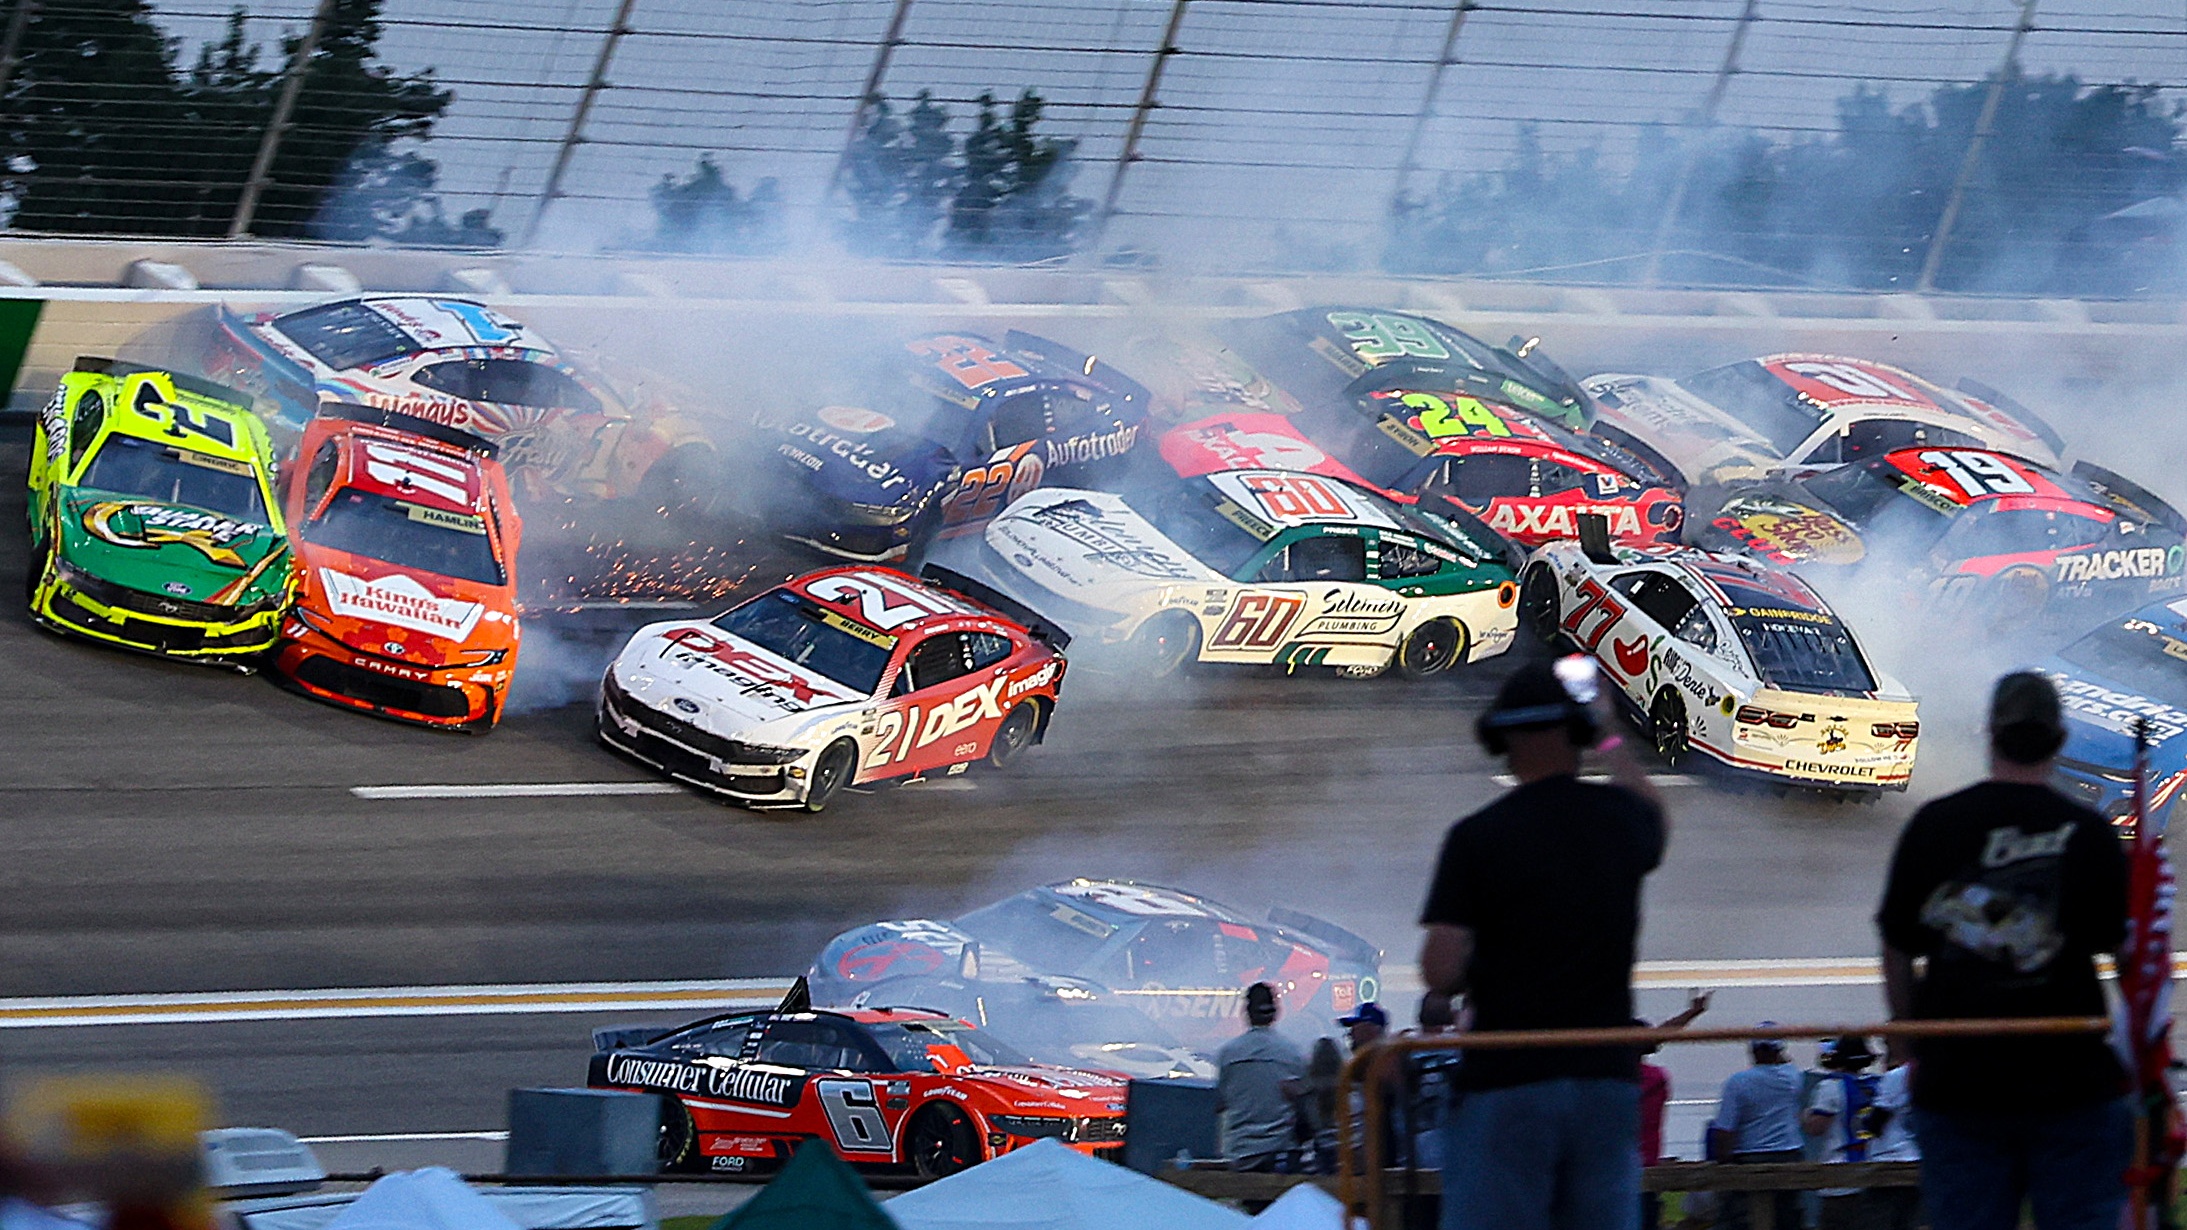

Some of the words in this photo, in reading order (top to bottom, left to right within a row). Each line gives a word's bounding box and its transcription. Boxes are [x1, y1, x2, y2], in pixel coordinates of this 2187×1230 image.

[1401, 392, 1511, 438] 24
[1046, 425, 1138, 470] Autotrader
[945, 462, 1013, 524] 22
[1919, 451, 2035, 496] 19
[423, 510, 478, 530] HAMLIN
[1245, 477, 1350, 519] 60
[2055, 549, 2166, 583] TRACKER
[339, 592, 461, 630] Hawaiian
[804, 573, 955, 630] 21
[1210, 596, 1304, 649] 60
[1564, 577, 1628, 653] 77
[1749, 607, 1833, 625] GAINBRIDGE
[841, 619, 878, 640] BERRY
[1317, 620, 1378, 632] PLUMBING
[354, 657, 428, 680] CAMRY
[661, 626, 844, 704] DEX
[674, 652, 803, 713] imaging
[916, 675, 1008, 748] DEX
[863, 706, 921, 769] 21
[1785, 759, 1876, 777] CHEVROLET
[607, 1053, 706, 1093] Consumer
[708, 1064, 791, 1105] Cellular
[923, 1086, 968, 1101] GOODYEAR
[820, 1080, 891, 1150] 6
[712, 1157, 744, 1166] FORD
